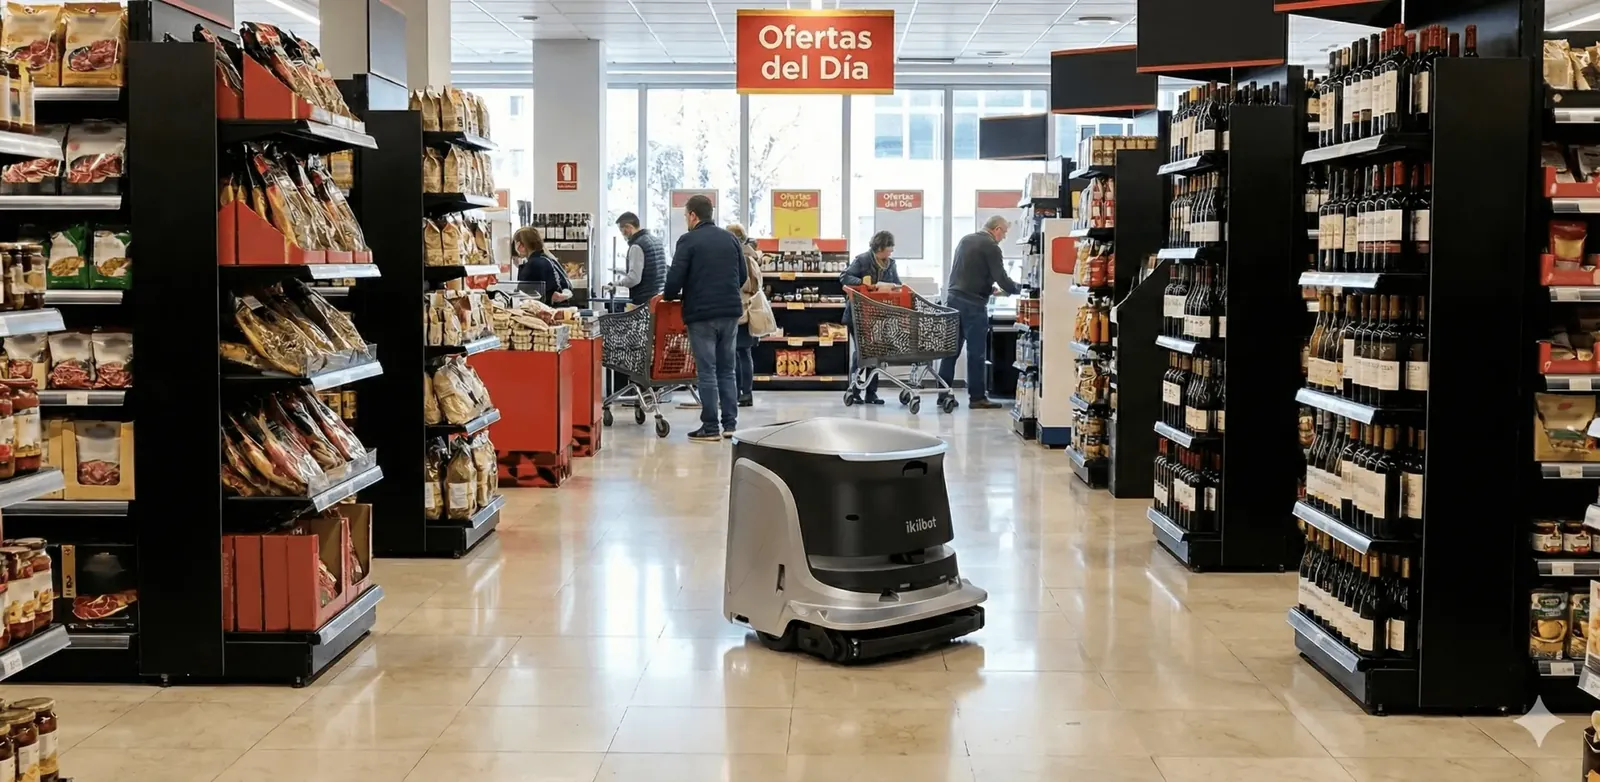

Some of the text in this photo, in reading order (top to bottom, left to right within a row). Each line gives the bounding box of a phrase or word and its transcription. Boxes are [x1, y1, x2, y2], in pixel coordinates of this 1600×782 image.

[758, 24, 873, 50] Ofertas
[761, 54, 869, 80] del Día
[883, 192, 915, 201] Ofertas
[885, 200, 898, 208] del
[905, 515, 937, 534] ikilbot
